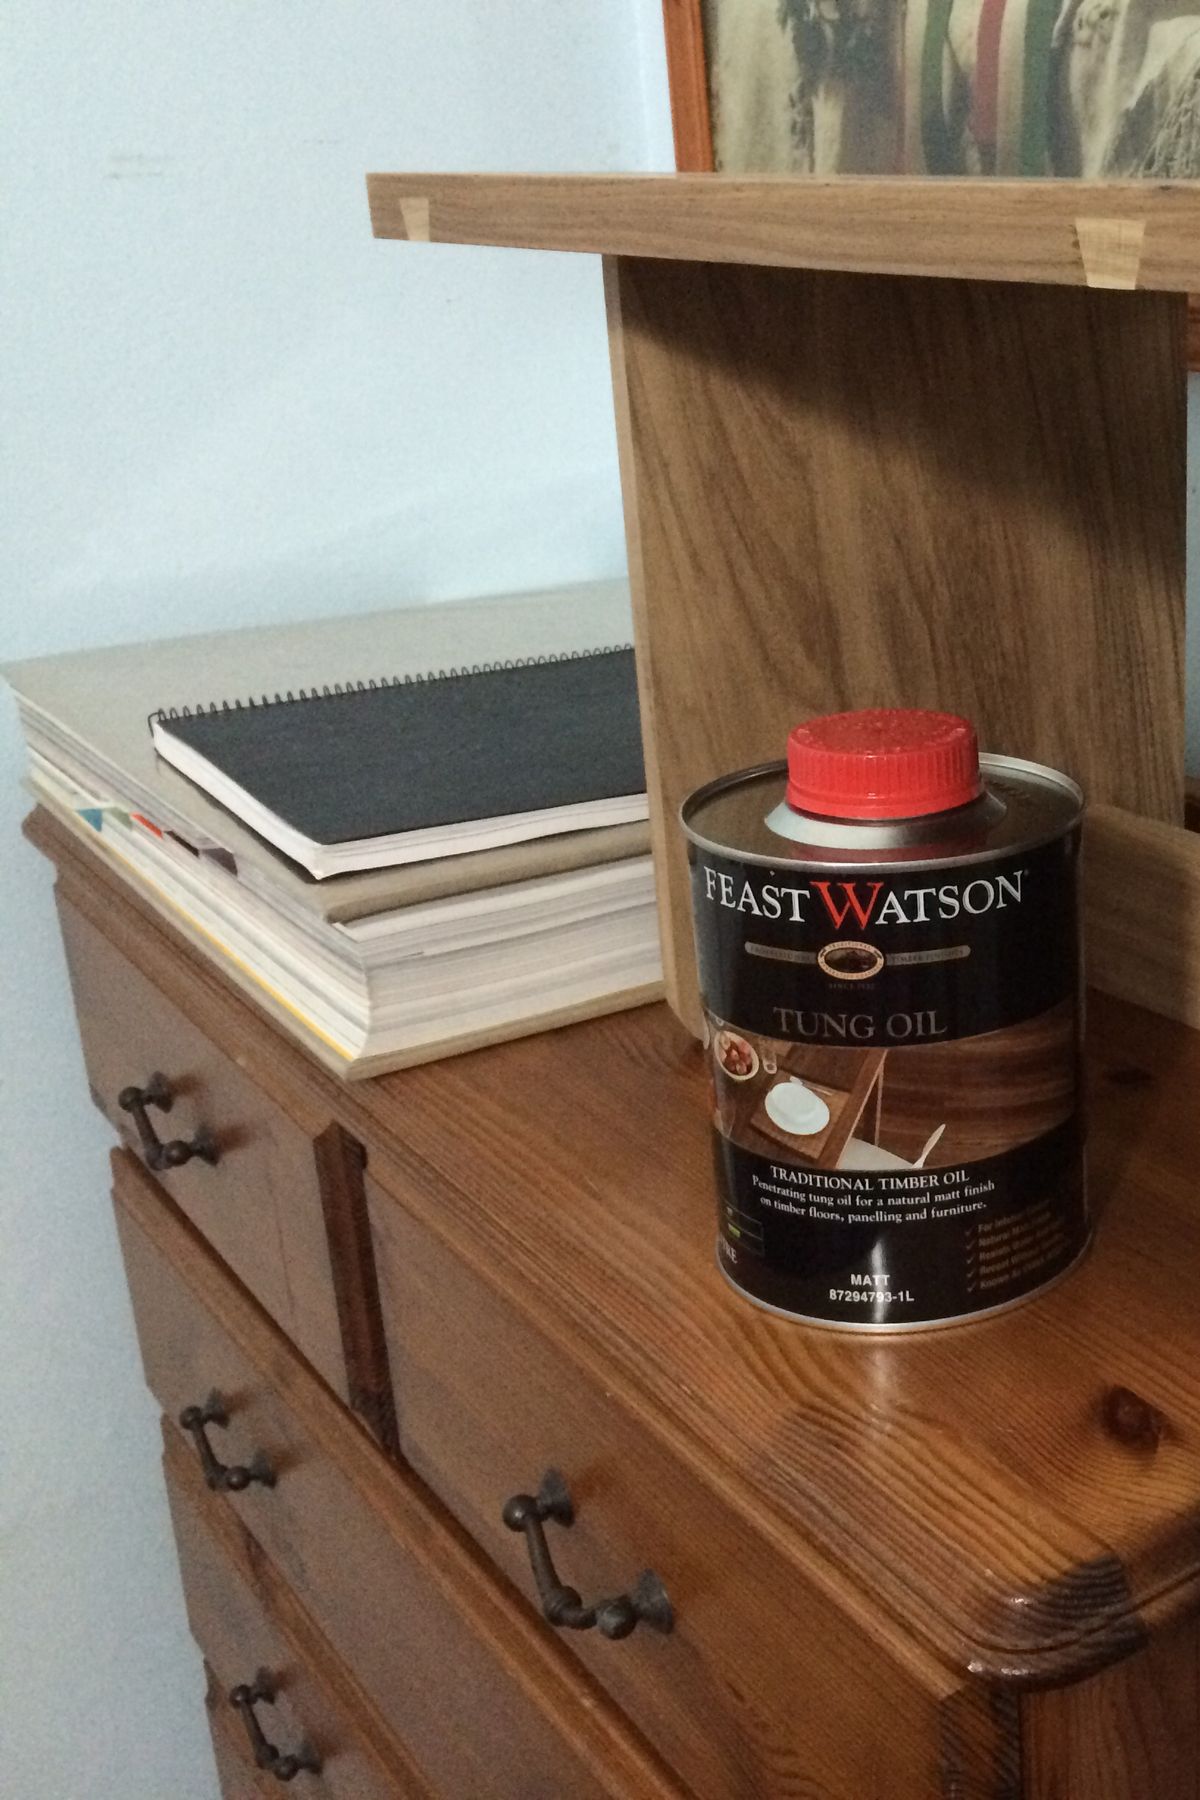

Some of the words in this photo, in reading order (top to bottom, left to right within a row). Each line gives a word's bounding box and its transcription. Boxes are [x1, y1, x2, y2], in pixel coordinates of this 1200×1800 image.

[703, 866, 810, 922] FEAST
[809, 870, 1023, 931] WATSON
[773, 1006, 876, 1039] TUNG
[886, 1010, 948, 1038] OIL
[752, 1174, 806, 1203] Penetrating
[809, 1194, 834, 1207] tung
[837, 1194, 852, 1206] oil
[856, 1195, 873, 1207] for
[887, 1191, 930, 1206] natural
[934, 1190, 960, 1203] matt
[964, 1180, 995, 1198] finish
[770, 1165, 874, 1191] TRADITIONAL
[878, 1174, 940, 1190] TIMBER
[943, 1169, 970, 1185] OIL
[760, 1196, 771, 1207] on
[774, 1202, 806, 1216] timber
[809, 1206, 844, 1222] floors,
[848, 1210, 902, 1224] panelling
[905, 1207, 928, 1220] and
[931, 1201, 987, 1219] furniture.
[850, 1273, 890, 1287] MATT
[829, 1288, 915, 1303] 87294793-1L
